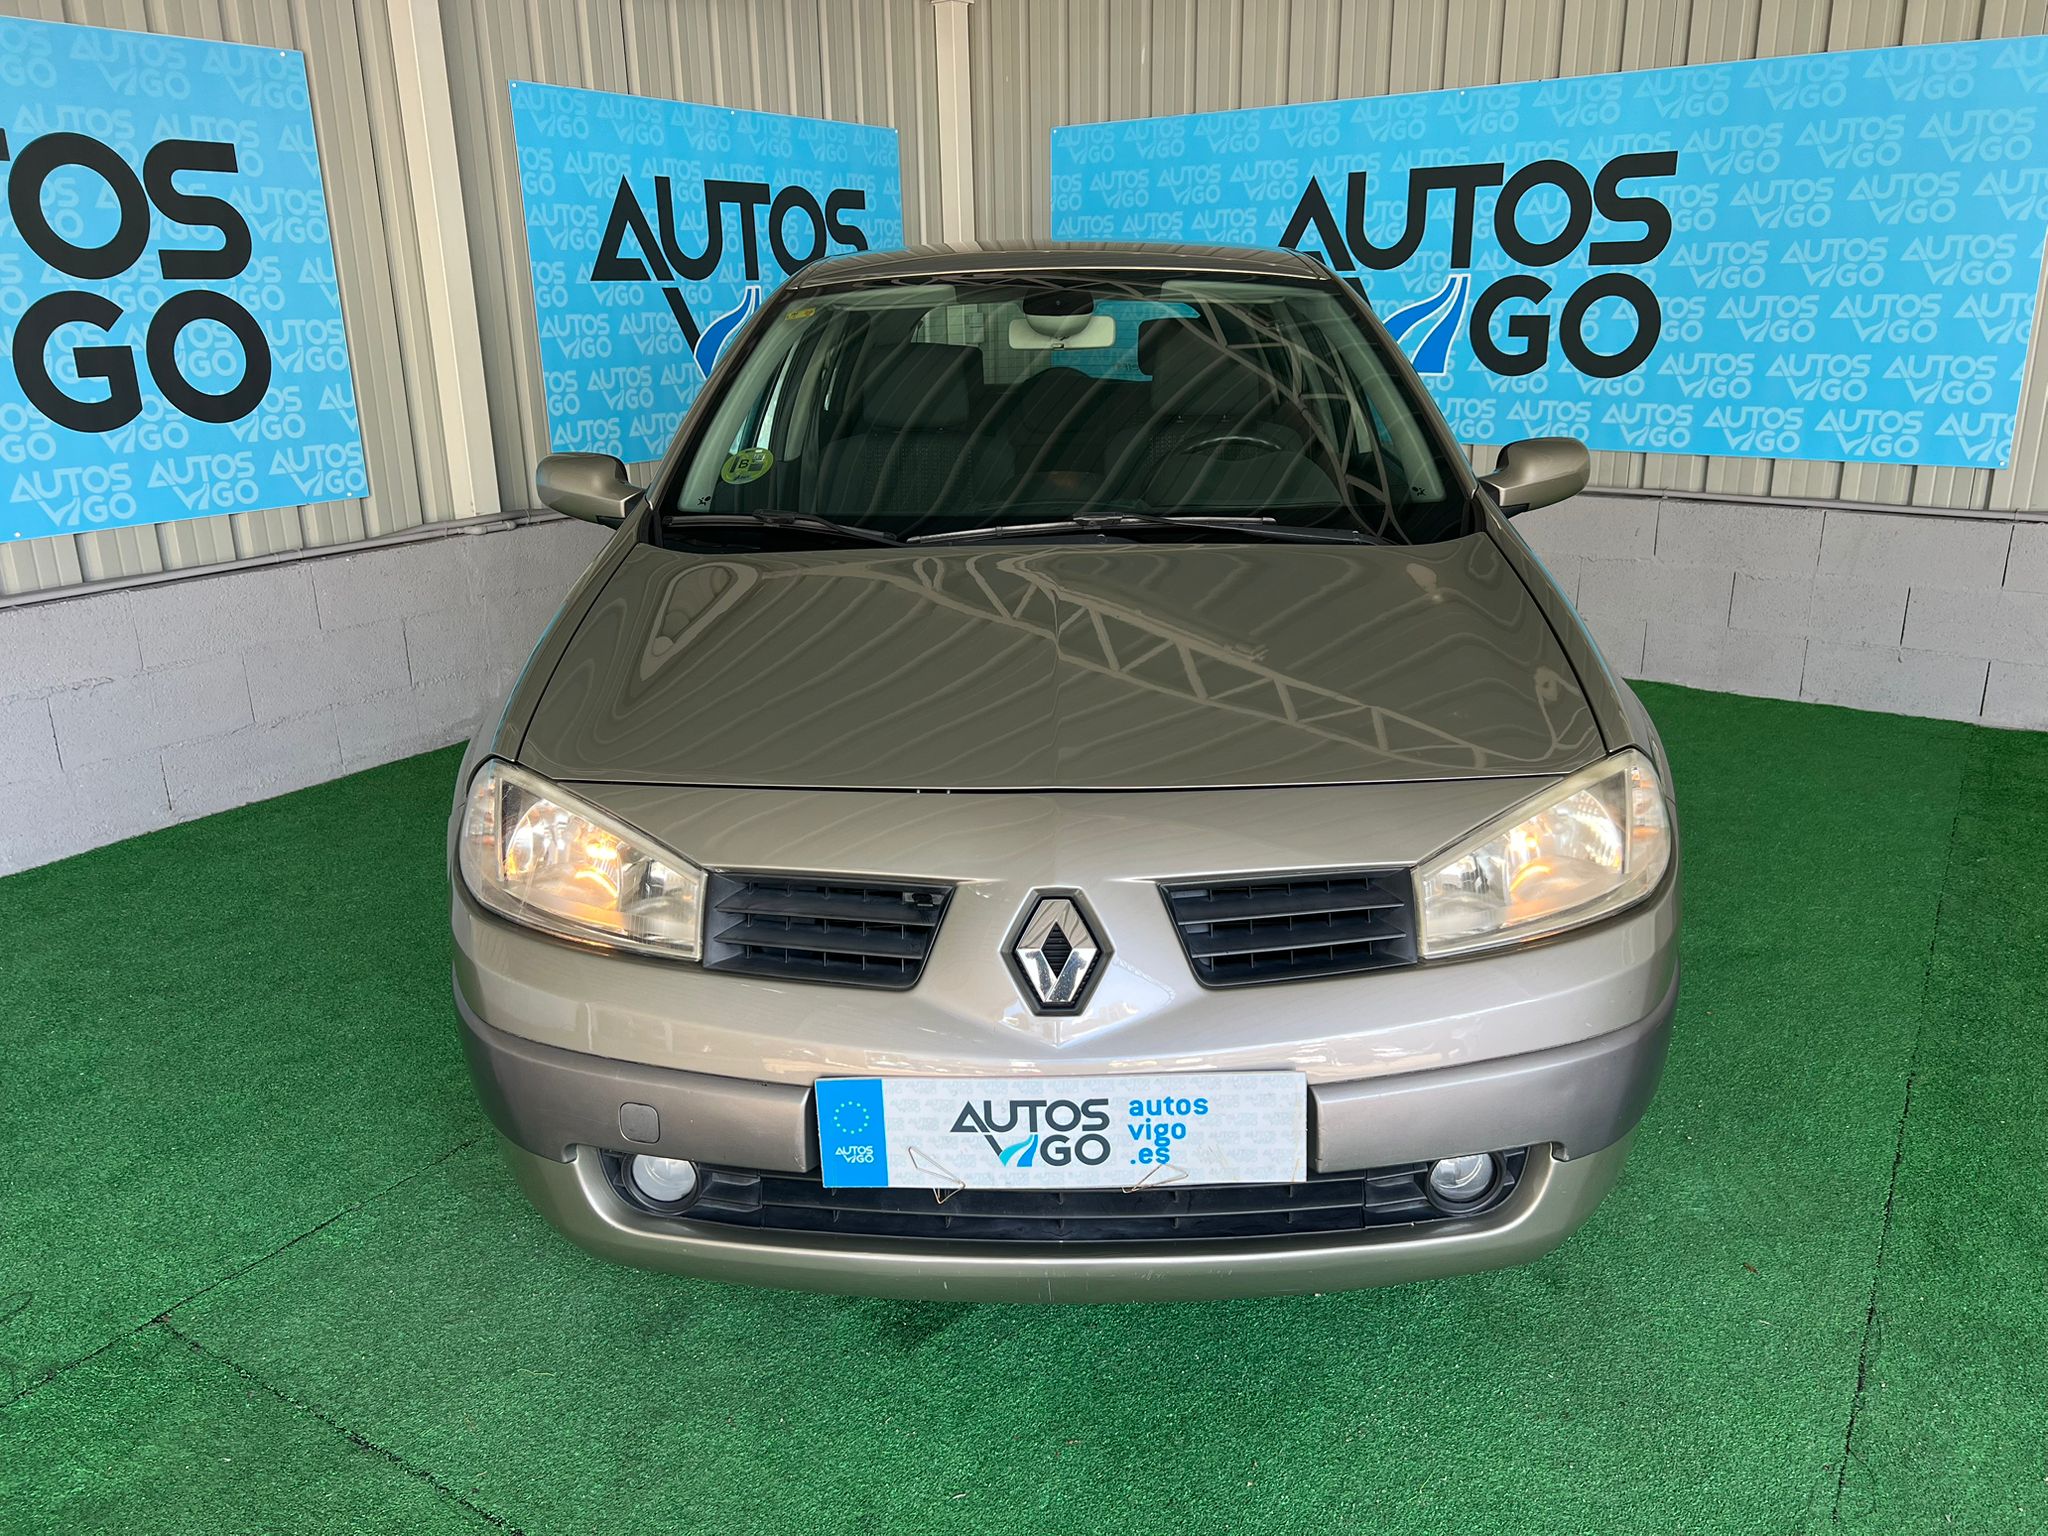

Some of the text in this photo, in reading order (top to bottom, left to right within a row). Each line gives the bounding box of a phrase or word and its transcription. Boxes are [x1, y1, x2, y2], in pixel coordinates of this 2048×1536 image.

[70, 31, 187, 70] AUTOS
[1863, 46, 1980, 79] AUTOS
[98, 63, 192, 100] VIGO
[1634, 66, 1733, 98] AUTOS
[1744, 55, 1851, 89] AUTOS
[226, 73, 308, 111] VIGO
[1533, 76, 1624, 107] AUTOS
[1765, 81, 1847, 112] VIGO
[1882, 72, 1975, 101] VIGO
[1351, 95, 1428, 123] AUTOS
[1438, 86, 1521, 115] AUTOS
[1654, 91, 1730, 119] VIGO
[13, 103, 135, 139] AUTOS
[1194, 111, 1260, 136] AUTOS
[1270, 104, 1341, 129] AUTOS
[1455, 110, 1520, 135] VIGO
[1552, 101, 1621, 127] VIGO
[1918, 106, 2038, 138] AUTOS
[1058, 127, 1115, 147] AUTOS
[1123, 119, 1186, 142] AUTOS
[1207, 132, 1260, 154] VIGO
[1284, 125, 1340, 148] VIGO
[1366, 118, 1426, 142] VIGO
[1682, 123, 1784, 153] AUTOS
[1796, 114, 1906, 146] AUTOS
[1070, 145, 1115, 164] VIGO
[1137, 139, 1185, 160] VIGO
[1703, 148, 1780, 175] VIGO
[1818, 141, 1902, 169] VIGO
[1941, 135, 2032, 163] VIGO
[565, 151, 632, 177] AUTOS
[1158, 163, 1221, 187] AUTOS
[1231, 158, 1299, 182] AUTOS
[580, 174, 621, 199] VIG
[1091, 168, 1150, 191] AUTOS
[1244, 180, 1299, 201] VIGO
[1730, 177, 1835, 206] AUTOS
[1847, 171, 1962, 200] AUTOS
[1103, 188, 1149, 209] VIGO
[1169, 184, 1221, 205] VIGO
[529, 203, 599, 228] AUTOS
[1122, 211, 1184, 233] AUTOS
[1192, 207, 1258, 230] AUTOS
[1278, 150, 1678, 271] AUTOS
[1751, 203, 1832, 229] VIGO
[1869, 198, 1957, 225] VIGO
[249, 213, 329, 244] VIGO
[545, 226, 601, 251] VIGO
[590, 174, 869, 281] AUTOS
[1058, 215, 1115, 236] AUTOS
[1670, 240, 1770, 266] AUTOS
[1781, 237, 1888, 264] AUTOS
[1901, 233, 2017, 261] AUTOS
[1689, 265, 1766, 289] VIGO
[1802, 263, 1885, 287] VIGO
[1923, 260, 2013, 286] VIGO
[592, 284, 644, 307] VIGO
[1717, 295, 1820, 319] AUTOS
[1831, 293, 1943, 319] AUTOS
[266, 319, 345, 352] UTOS
[541, 313, 610, 338] AUTOS
[1737, 319, 1816, 343] VIGO
[1850, 318, 1938, 343] VIGO
[558, 335, 612, 359] VIGO
[633, 332, 683, 355] VIGO
[1658, 352, 1756, 376] AUTOS
[1766, 353, 1872, 378] AUTOS
[1883, 354, 1998, 380] AUTOS
[588, 365, 652, 391] AUTOS
[1677, 375, 1752, 399] VIGO
[1787, 377, 1868, 402] VIGO
[603, 387, 654, 411] VIGO
[1904, 379, 1993, 405] VIGO
[1507, 399, 1592, 421] AUTOS
[1602, 403, 1694, 427] AUTOS
[1704, 405, 1805, 430] AUTOS
[1815, 408, 1924, 435] AUTOS
[554, 417, 620, 446] AUTOS
[1620, 426, 1691, 449] VIGO
[1723, 428, 1801, 453] VIGO
[1835, 432, 1920, 458] VIGO
[148, 450, 256, 489] AUTOS
[269, 441, 362, 476] AUTOS
[10, 462, 133, 504] AUTOS
[173, 480, 260, 511] VIGO
[290, 467, 367, 498] VIGO
[39, 492, 137, 528] VIGO
[949, 1098, 1111, 1134] AUTOS
[1129, 1096, 1209, 1116] autos
[1127, 1117, 1187, 1147] vigo
[835, 1145, 874, 1156] AUTOS
[842, 1154, 874, 1164] VIGO
[983, 1132, 1111, 1168] VIGO
[1129, 1146, 1171, 1166] .es
